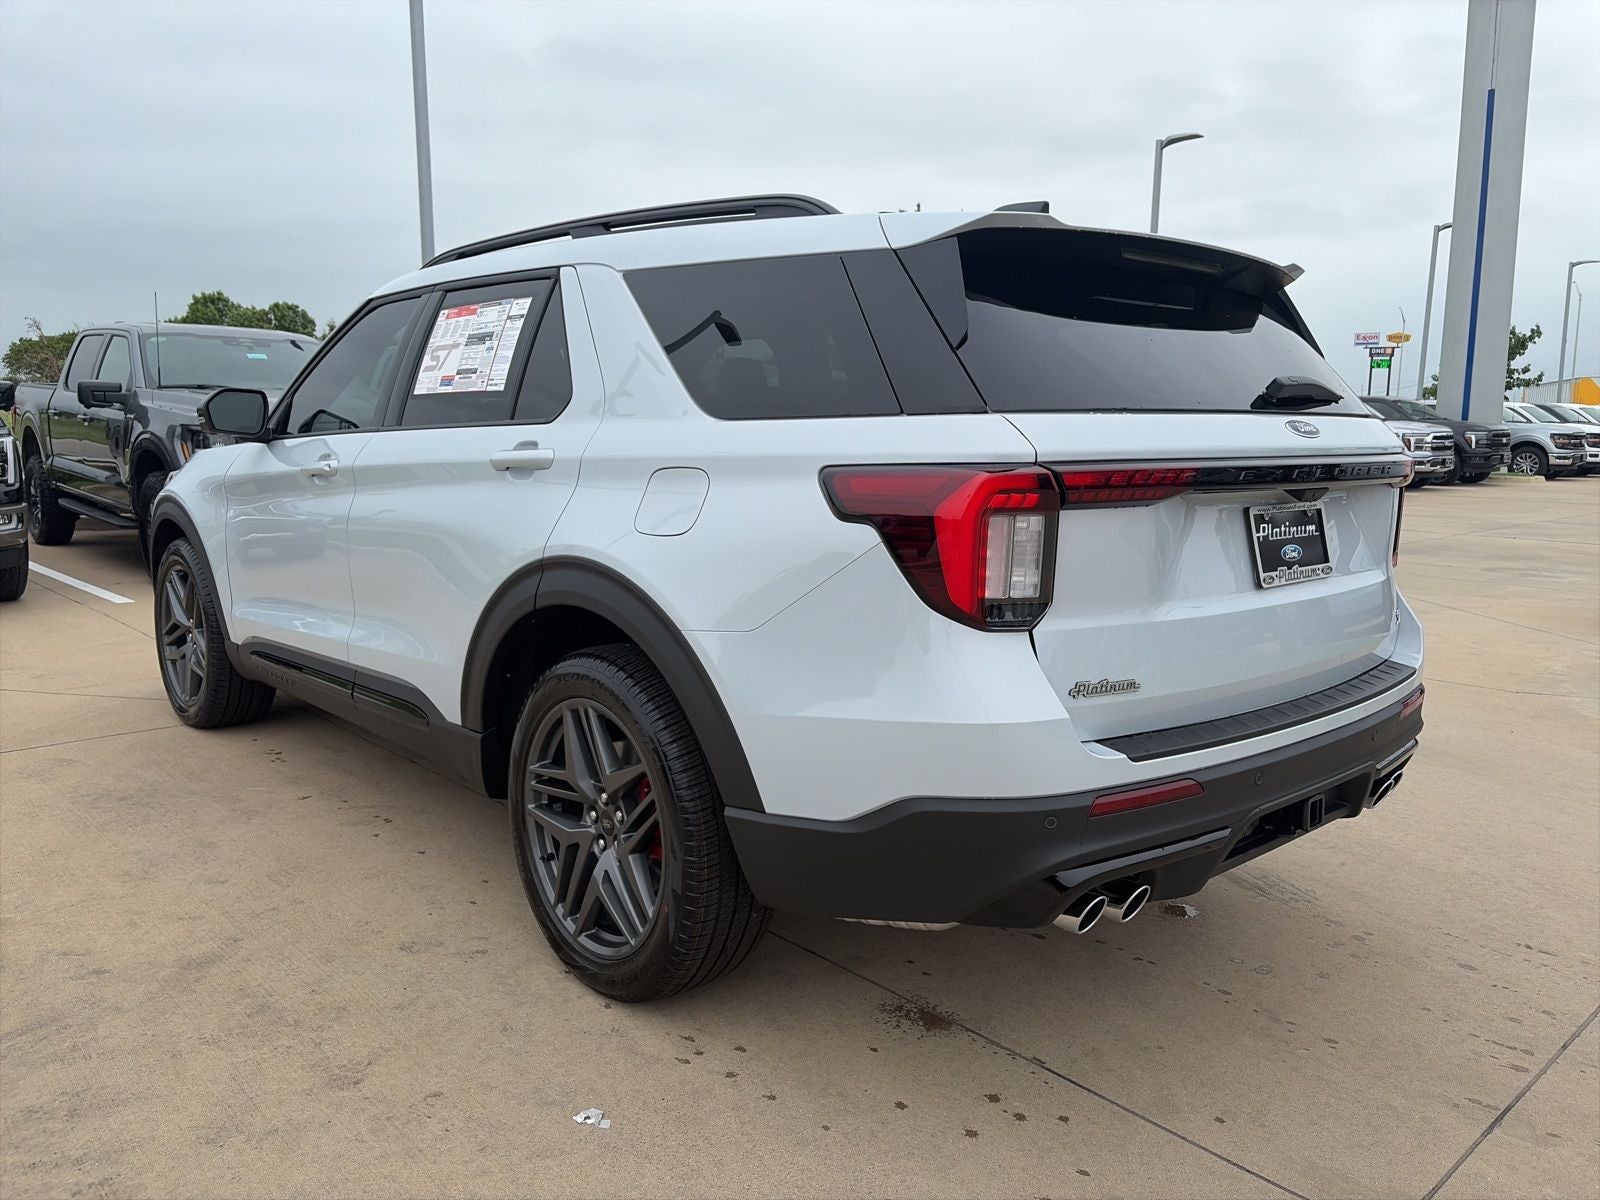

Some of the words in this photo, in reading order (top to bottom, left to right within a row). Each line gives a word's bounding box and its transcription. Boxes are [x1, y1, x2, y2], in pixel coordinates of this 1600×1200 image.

[1356, 334, 1378, 342] Exxon
[422, 342, 462, 373] ST
[1256, 521, 1320, 541] Platinum
[1284, 546, 1299, 559] Ford
[1277, 565, 1320, 583] Platinum
[1069, 679, 1141, 699] Platinum
